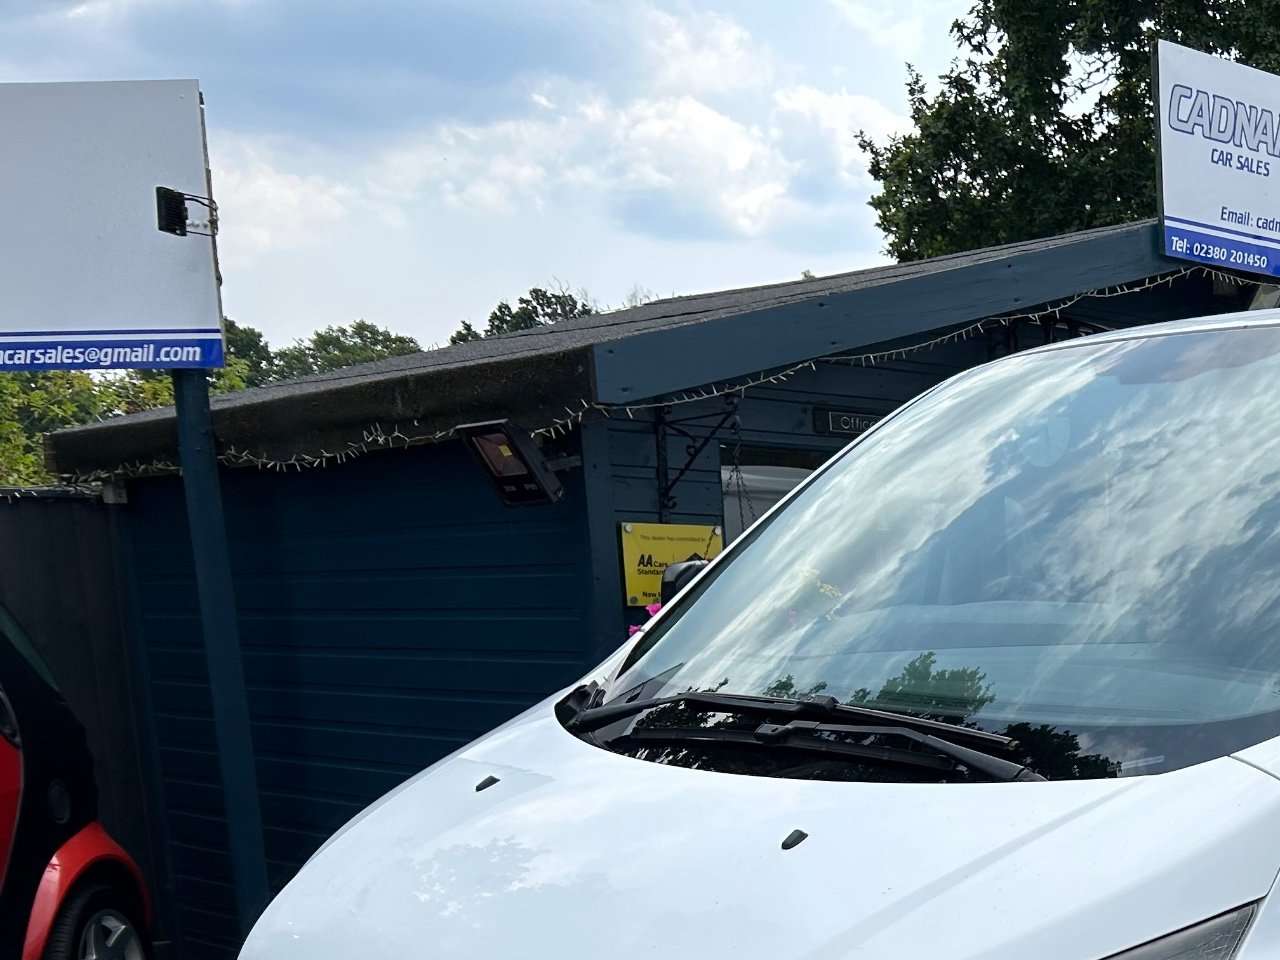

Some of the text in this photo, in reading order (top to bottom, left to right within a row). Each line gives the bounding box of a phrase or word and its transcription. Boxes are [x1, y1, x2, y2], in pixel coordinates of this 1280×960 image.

[1211, 148, 1270, 177] CAR SALES
[1221, 206, 1253, 227] Email:
[1171, 236, 1268, 268] Tel: 02380 201450
[638, 554, 652, 567] AA
